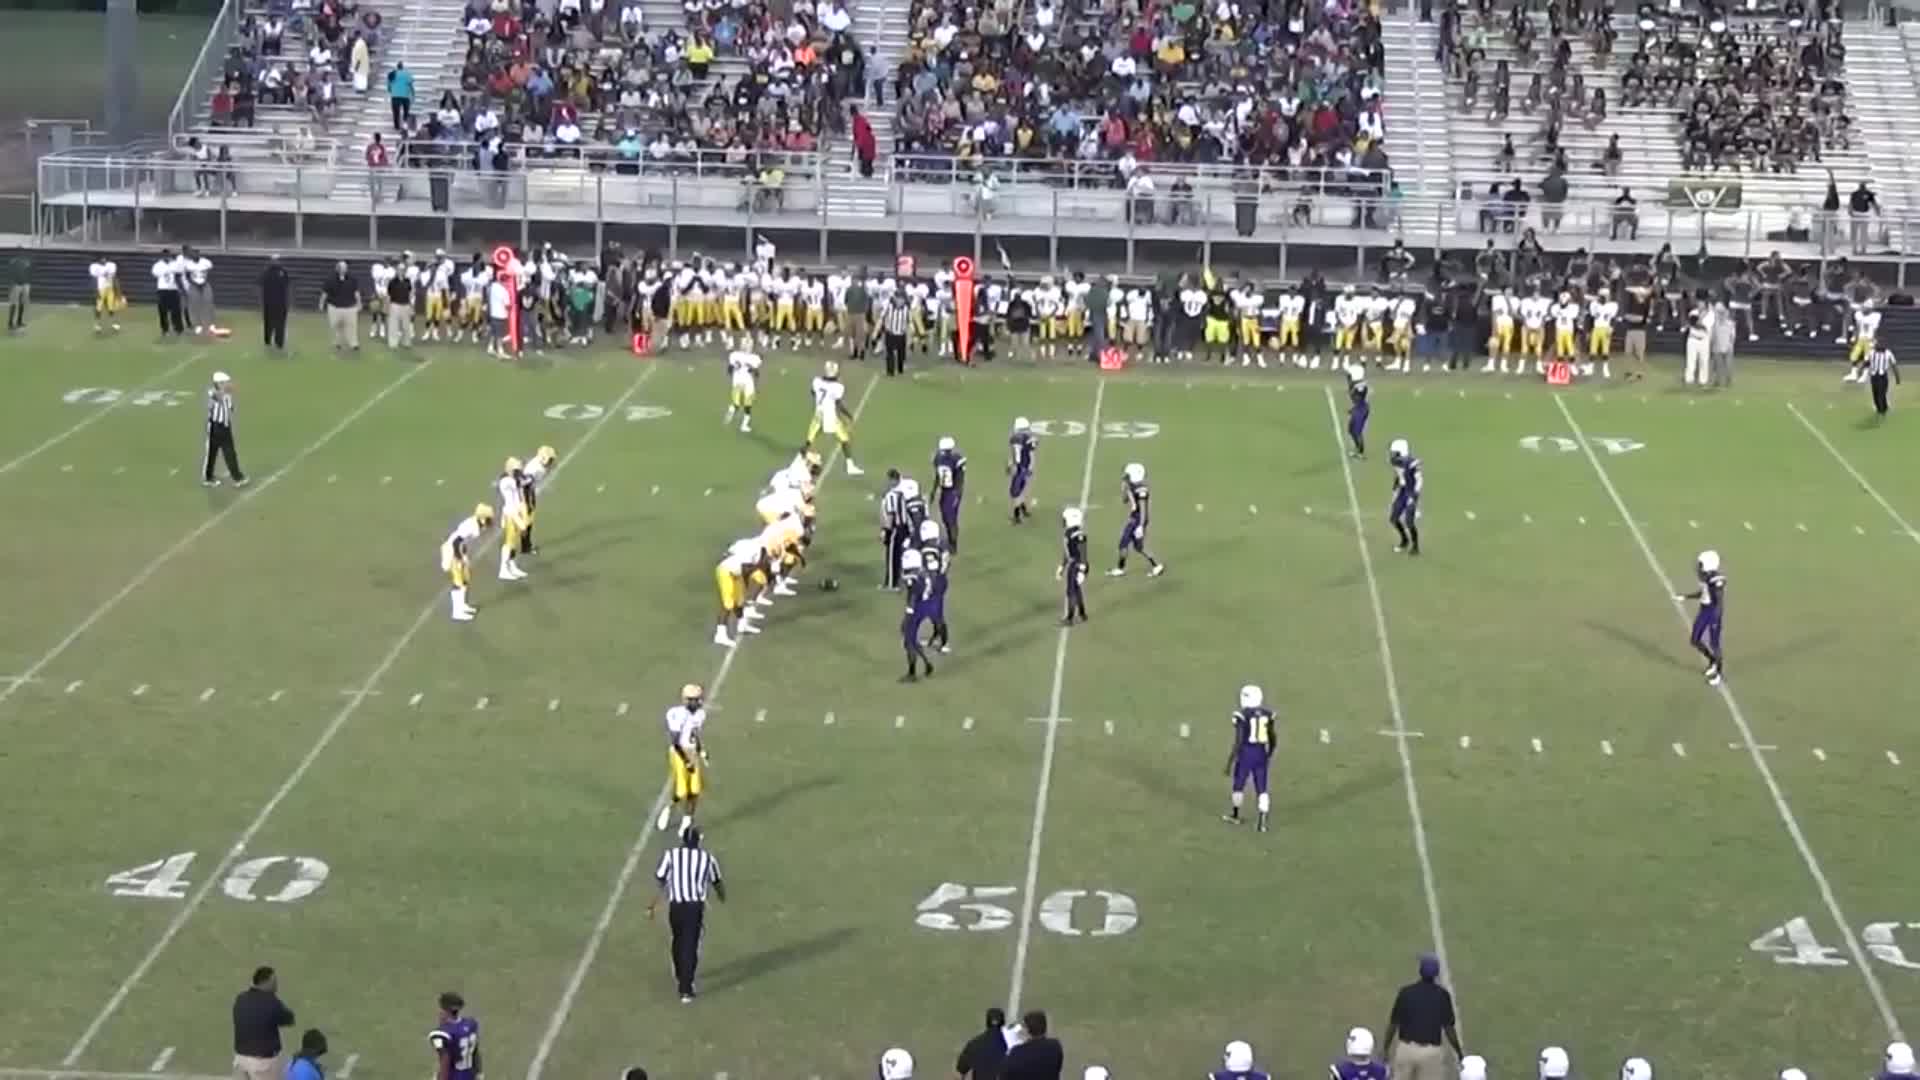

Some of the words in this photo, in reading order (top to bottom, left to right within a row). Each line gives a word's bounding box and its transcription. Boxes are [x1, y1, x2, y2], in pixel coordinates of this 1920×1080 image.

[105, 851, 330, 901] 40
[915, 882, 1137, 936] 50
[1750, 917, 1920, 969] 40
